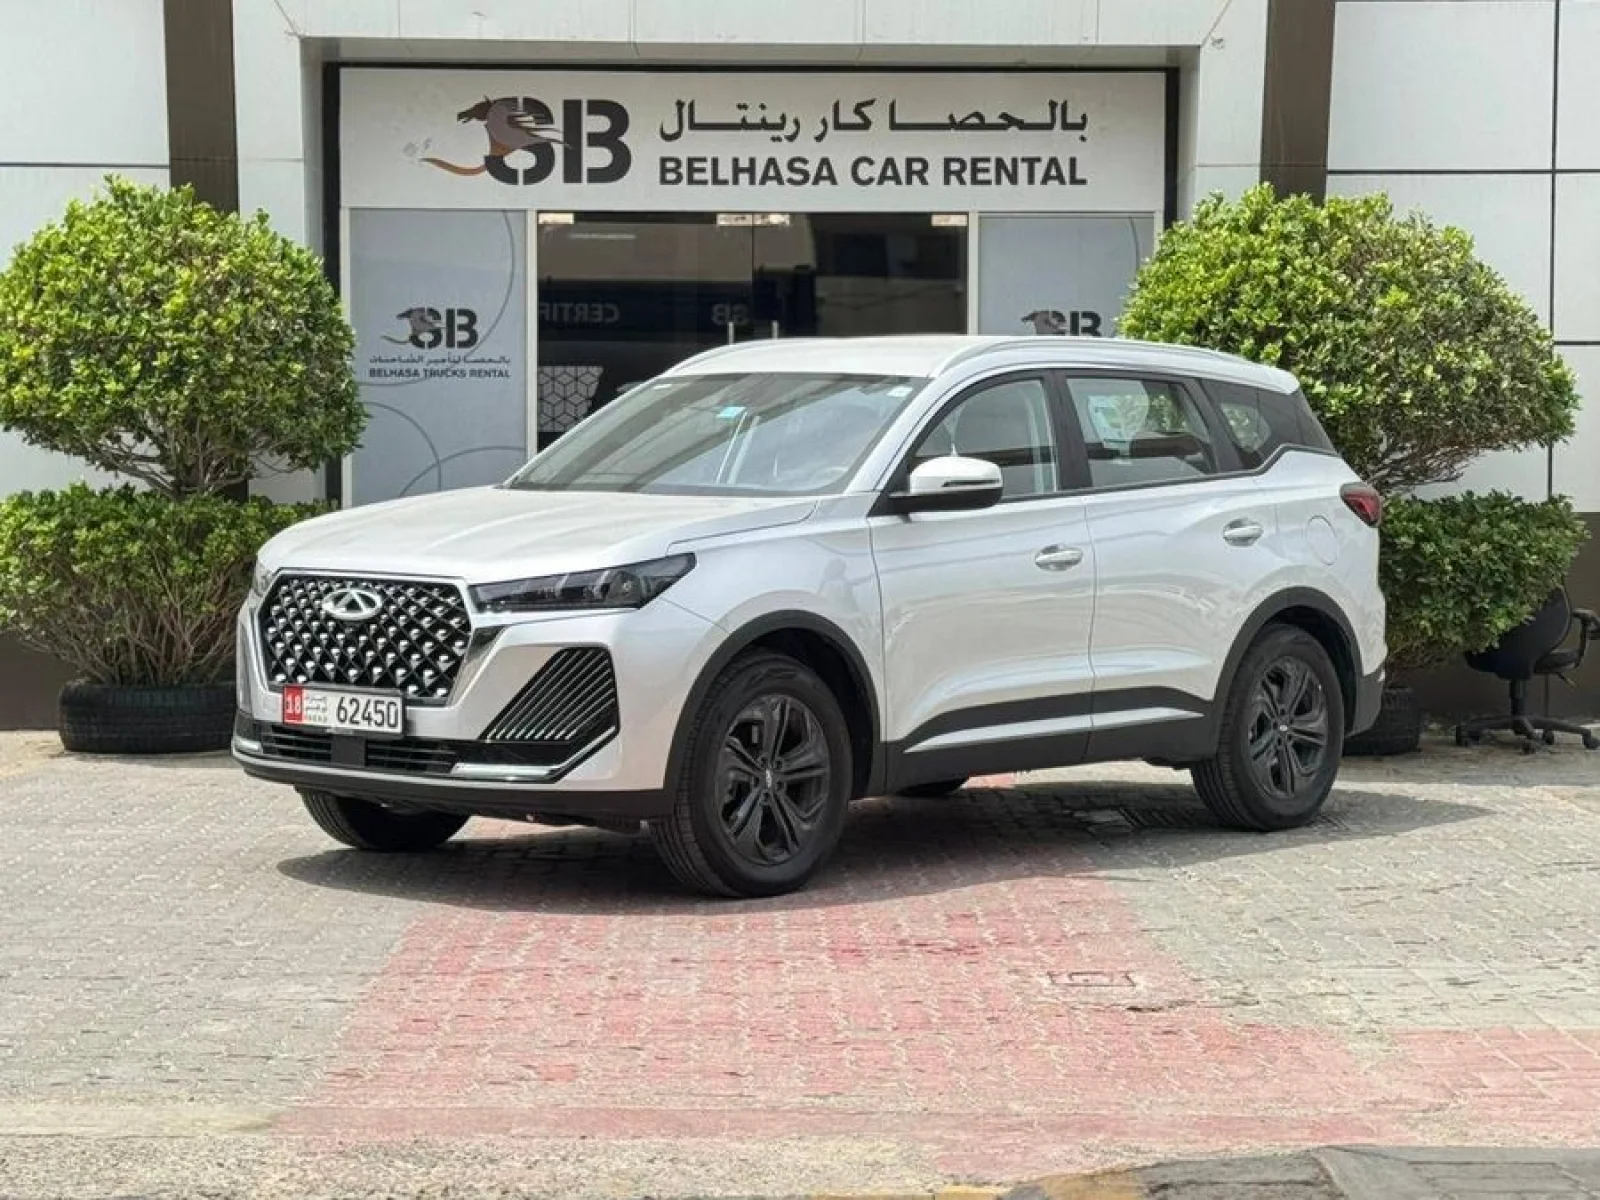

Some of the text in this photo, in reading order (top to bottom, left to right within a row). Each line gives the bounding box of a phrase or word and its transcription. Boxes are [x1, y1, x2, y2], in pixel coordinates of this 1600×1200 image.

[659, 98, 1088, 142] بالحصا كار رينتال
[659, 156, 1088, 186] BELHASA CAR RENTAL
[369, 367, 512, 379] BELHASA TRUCKS RENTAL
[336, 696, 399, 729] 62450
